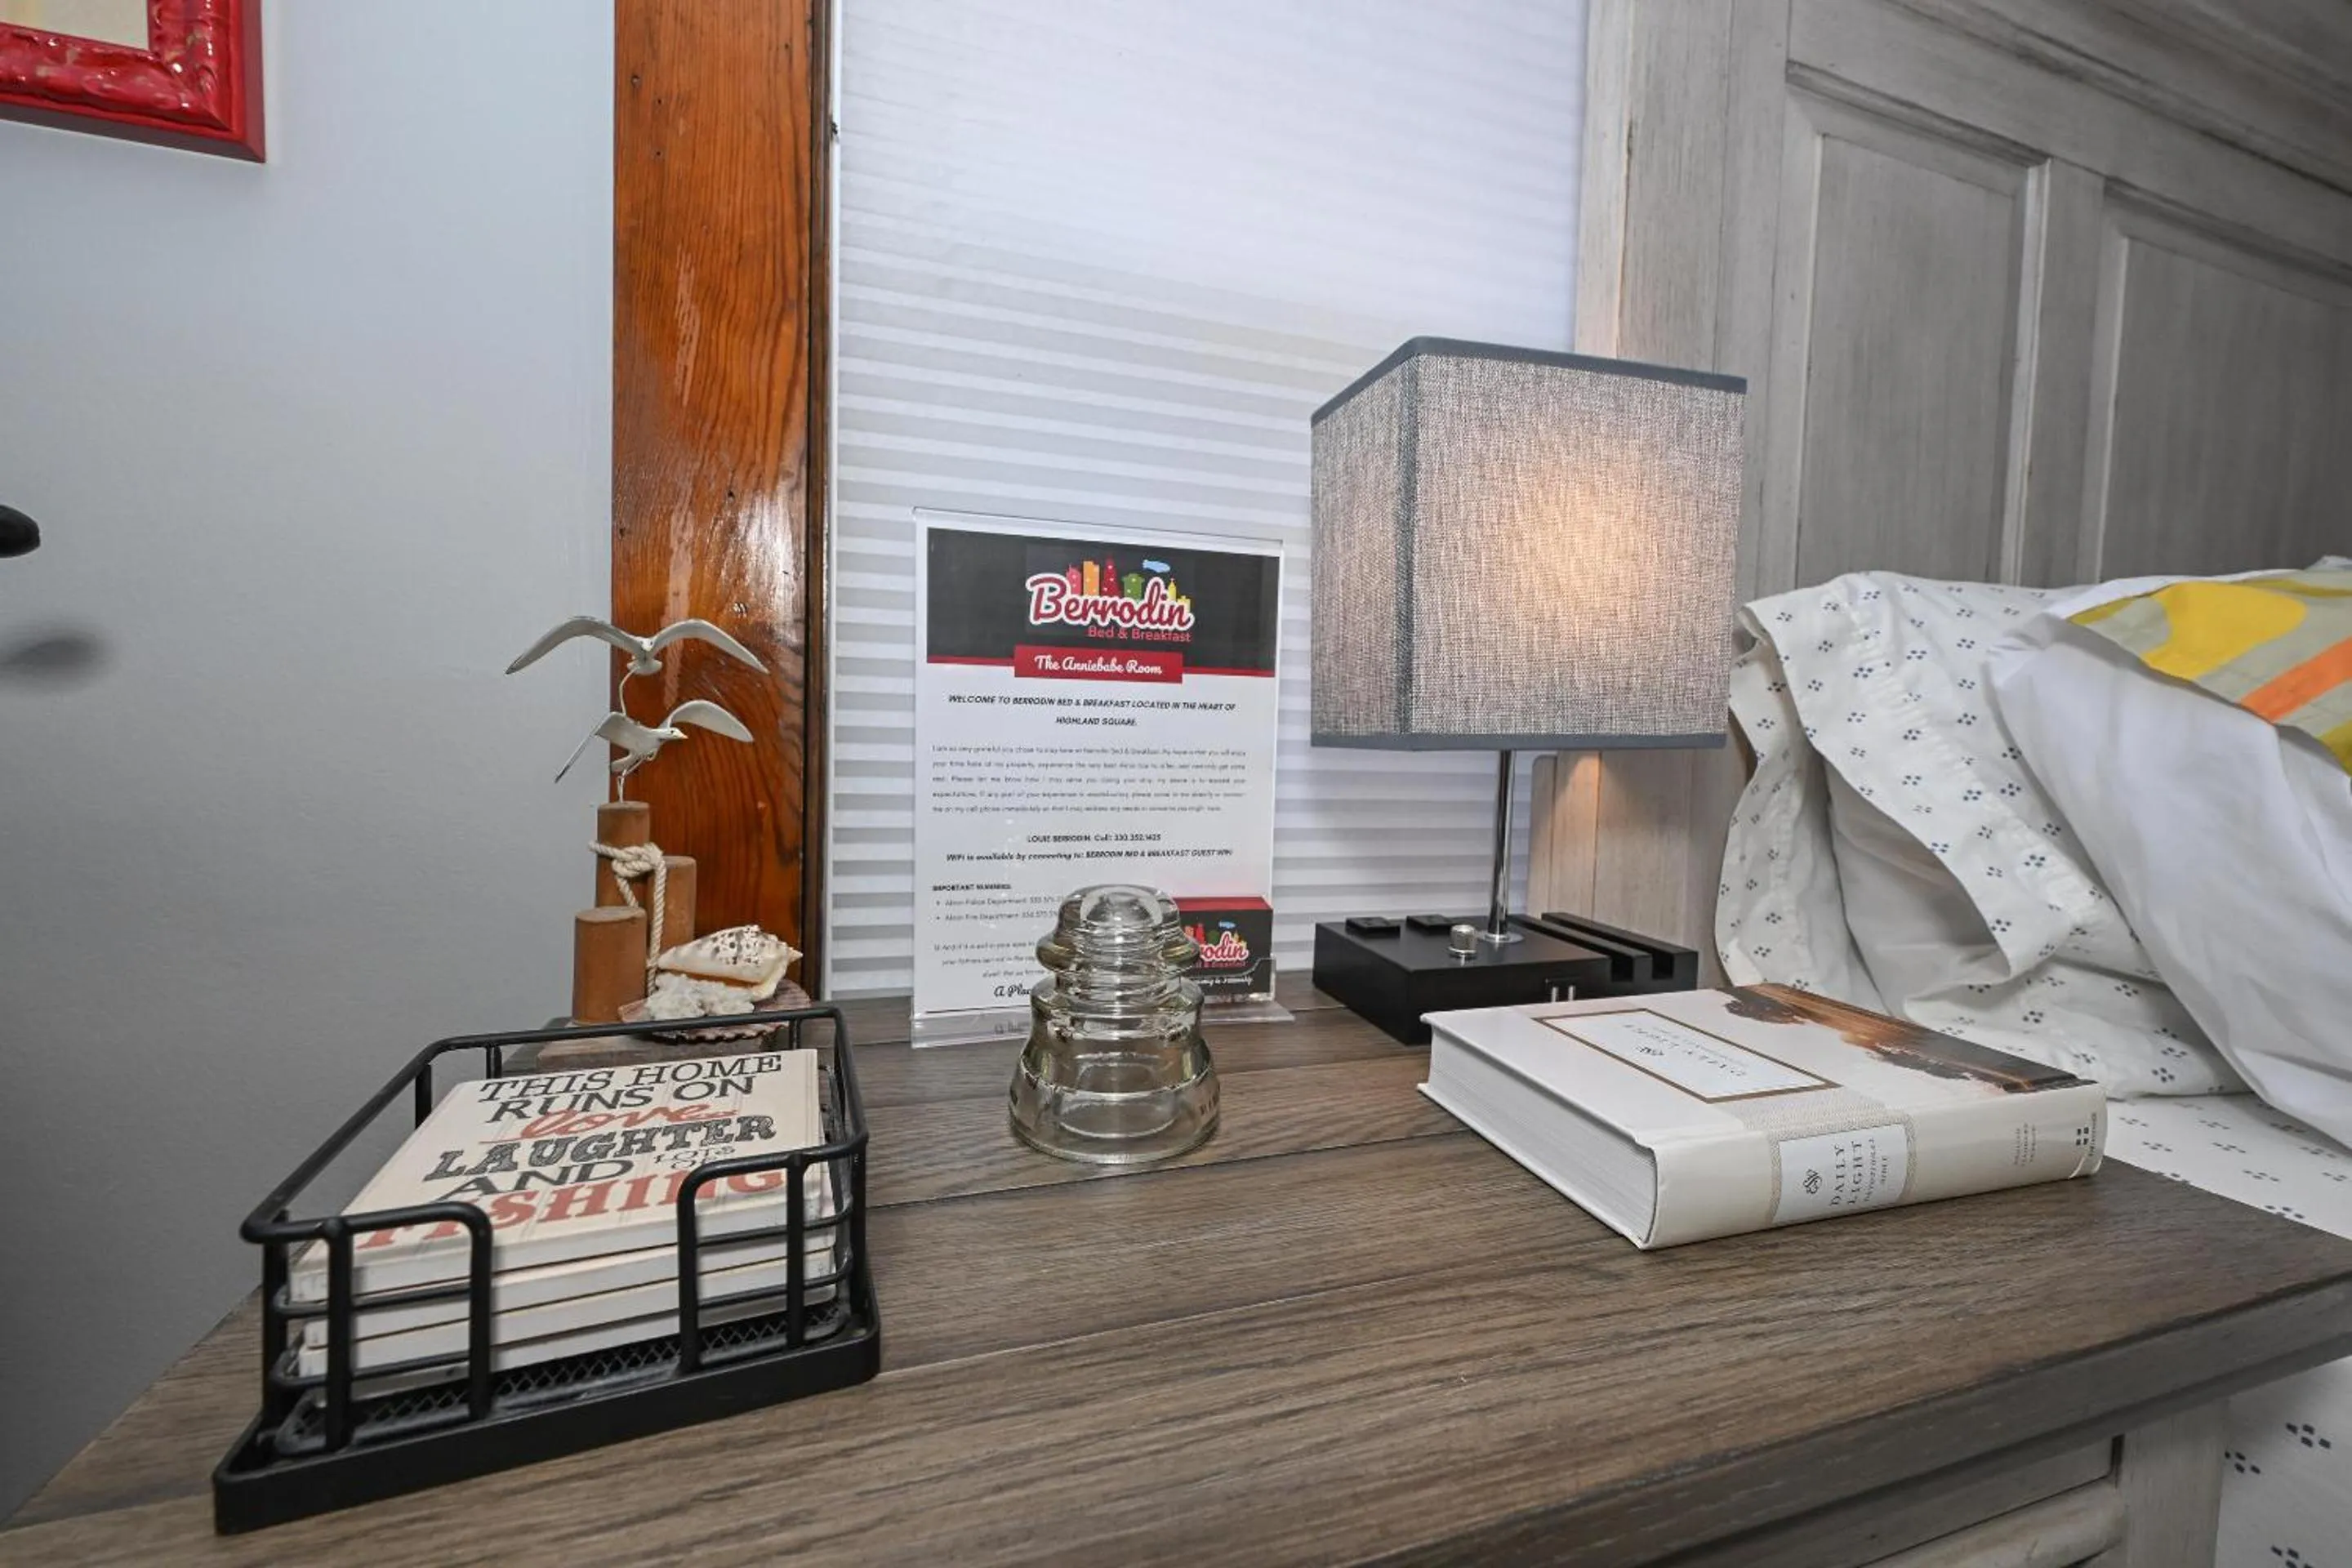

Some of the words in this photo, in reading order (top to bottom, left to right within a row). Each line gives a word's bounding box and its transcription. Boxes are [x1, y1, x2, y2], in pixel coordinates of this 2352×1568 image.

[1027, 574, 1194, 630] Berrodin
[1088, 626, 1116, 639] Bed
[1118, 626, 1128, 639] &
[1132, 628, 1192, 644] Breakfast
[1035, 655, 1060, 670] The
[1062, 656, 1125, 674] Anniebabe
[1126, 659, 1162, 675] Room
[949, 695, 996, 703] WELCOME
[998, 696, 1010, 704] TO
[1013, 697, 1056, 705] BERRODIN
[1083, 699, 1131, 708] BREAKFAST
[1132, 701, 1170, 709] LOCATED
[1198, 702, 1224, 710] HEART
[1056, 717, 1099, 725] HIGHLAND
[976, 852, 1013, 860] available
[1016, 852, 1026, 862] by
[1029, 852, 1071, 861] connecting
[1147, 849, 1190, 858] BREAKFAST
[1192, 849, 1216, 857] GUEST
[479, 1071, 612, 1102] THIS
[626, 1054, 782, 1086] HOME
[485, 1087, 654, 1123] RUNS
[673, 1076, 755, 1101] ON
[482, 1103, 738, 1144] love
[424, 1116, 777, 1182] LAUGHTER
[431, 1159, 635, 1203] AND
[1829, 1143, 1846, 1206] DAILY
[1846, 1141, 1864, 1205] LIGHT
